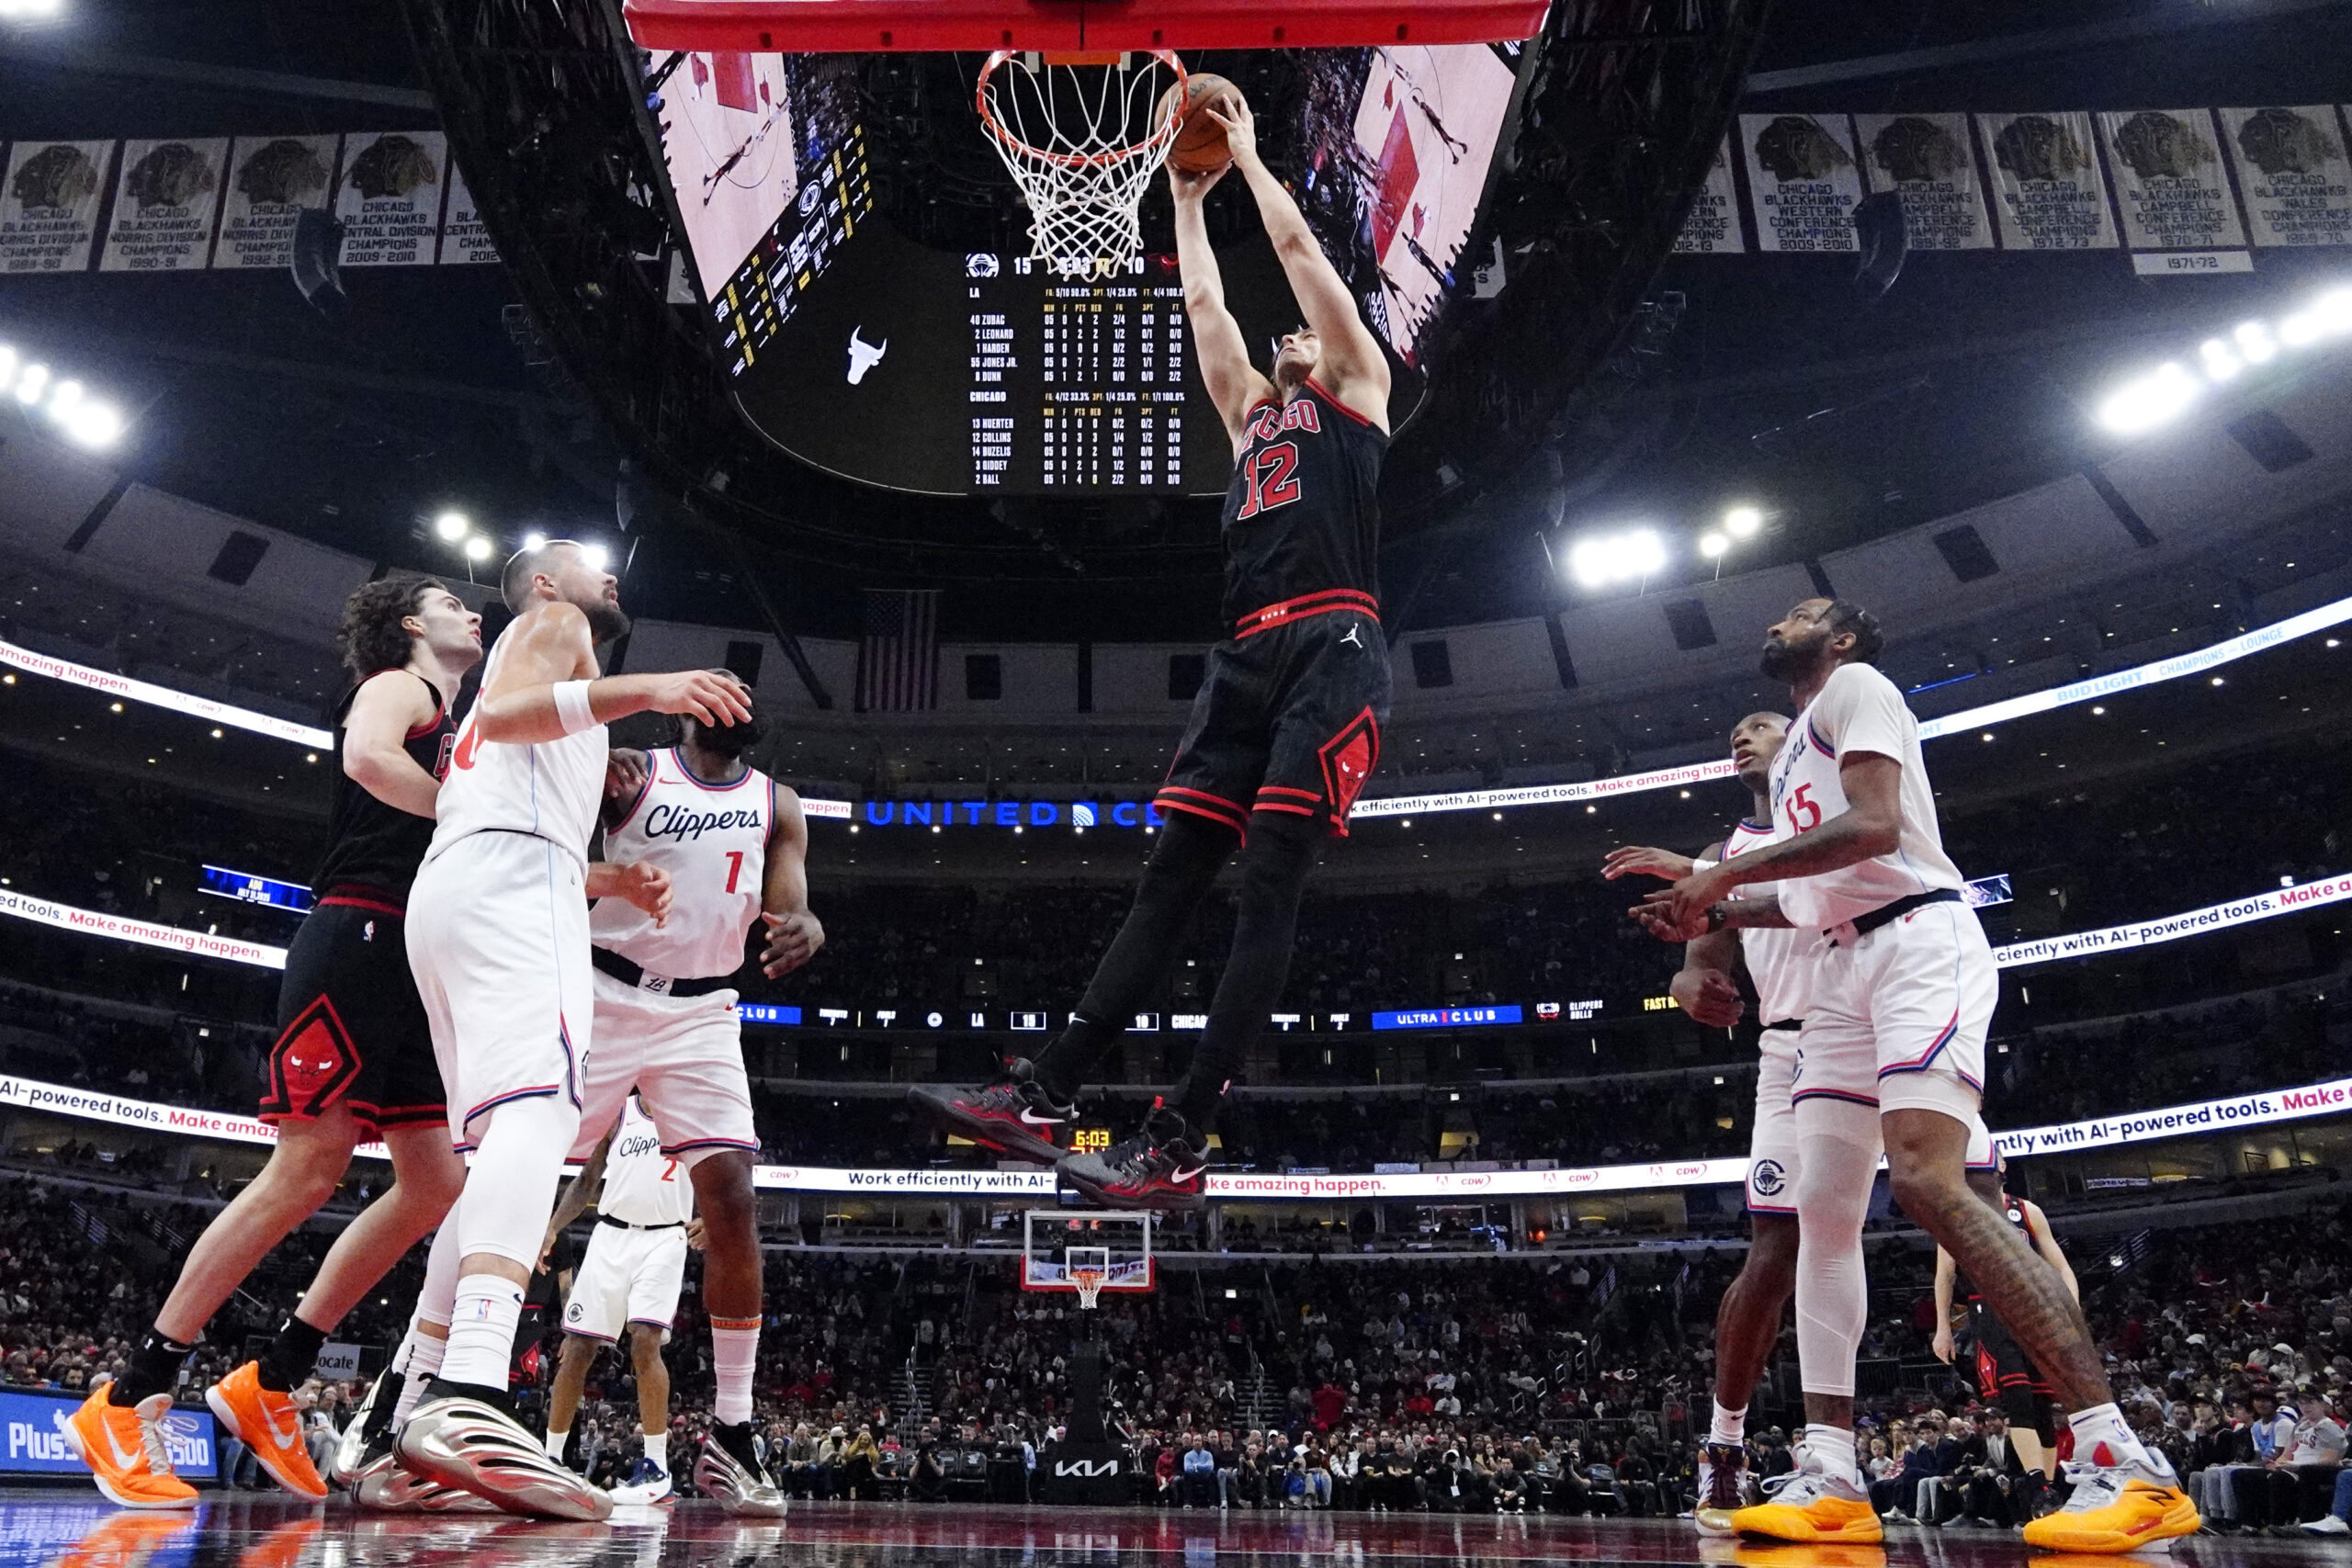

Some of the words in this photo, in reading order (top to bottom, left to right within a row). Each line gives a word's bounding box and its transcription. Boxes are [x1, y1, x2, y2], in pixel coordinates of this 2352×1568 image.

[1778, 184, 1833, 195] CHICAGO
[1765, 195, 1852, 206] BLACKHAWKS
[362, 202, 413, 212] CHICAGO
[1778, 207, 1842, 217] WESTERN
[344, 213, 426, 225] BLACKHAWKS
[1770, 217, 1855, 228] CONFERENCE
[390, 226, 435, 236] DIVISION
[1777, 229, 1852, 240] CHAMPIONS
[347, 238, 417, 250] CHAMPIONS
[1780, 240, 1853, 251] 2009-2010
[1013, 257, 1032, 275] 15
[2167, 256, 2219, 269] 1971-72
[969, 288, 979, 298] LA
[1166, 288, 1184, 297] 100.0
[970, 315, 980, 325] 40
[982, 315, 1005, 325] ZUBAC
[1045, 314, 1054, 325] 05
[1062, 314, 1068, 325] 0
[1078, 314, 1083, 325] 4
[1093, 314, 1099, 325] 2
[1114, 314, 1125, 325] 2/4
[1142, 314, 1154, 325] 0/0
[1170, 314, 1182, 325] 0/0
[975, 329, 980, 339] 2
[982, 329, 1013, 339] LEONARD
[977, 344, 980, 353] 1
[982, 344, 1010, 353] HARDEN
[971, 357, 980, 367] 55
[982, 357, 1004, 367] JONES
[976, 371, 980, 381] 8
[982, 371, 1001, 381] DUNN
[970, 391, 1006, 401] CHICAGO
[972, 418, 980, 428] 13
[982, 418, 1013, 428] HUERTER
[972, 433, 980, 443] 12
[982, 433, 1011, 443] COLLINS
[972, 446, 980, 457] 14
[982, 446, 1011, 457] BUZELIS
[976, 460, 980, 470] 3
[982, 460, 1007, 470] GIDDEY
[976, 474, 980, 484] 2
[982, 474, 1000, 484] BALL
[1237, 441, 1301, 520] 12
[2159, 649, 2226, 676] CHAMPIONS
[2241, 626, 2286, 651] LOUNGE
[68, 666, 131, 693] happen.
[2057, 686, 2091, 703] BUD
[2092, 671, 2143, 694] LIGHT
[1917, 721, 1942, 737] GHT
[1362, 797, 1429, 812] efficiently
[1433, 794, 1463, 807] with
[1467, 788, 1549, 805] AI-powered
[1553, 785, 1592, 797] tools.
[1596, 777, 1633, 793] Make
[1636, 769, 1700, 786] amazing
[1702, 763, 1738, 778] happ
[865, 802, 1058, 826] UNITED
[645, 805, 762, 842] Clippers
[725, 852, 743, 894] 1
[2064, 933, 2105, 951] with
[2110, 909, 2221, 942] AI-powered
[2223, 898, 2277, 919] tools.
[2280, 886, 2335, 907] Make
[21, 899, 63, 920] tools.
[69, 911, 117, 931] Make
[121, 927, 196, 950] amazing
[199, 937, 265, 960] happen.
[1569, 999, 1603, 1010] CLIPPERS
[1644, 998, 1667, 1010] FAST
[736, 1006, 777, 1020] CLUB
[1396, 1013, 1437, 1024] ULTRA
[1452, 1010, 1496, 1021] CLUB
[1570, 1010, 1592, 1020] BULLS
[971, 1013, 985, 1027] LA
[1023, 1014, 1036, 1028] 15
[1135, 1015, 1148, 1028] 10
[1171, 1014, 1208, 1029] CHICAG
[0, 1081, 111, 1113] AI-powered
[116, 1101, 164, 1123] tools.
[169, 1111, 222, 1132] Make
[226, 1120, 278, 1139] amaz
[2041, 1127, 2085, 1146] with
[2090, 1106, 2212, 1140] AI-powered
[2216, 1099, 2278, 1121] tools.
[2282, 1089, 2345, 1111] Make
[1076, 1131, 1109, 1146] 6:03
[620, 1135, 660, 1157] Clipp
[662, 1157, 677, 1182] 2
[1676, 1167, 1700, 1176] CDW
[849, 1172, 892, 1185] Work
[896, 1172, 982, 1190] efficiently
[987, 1172, 1023, 1187] with
[1461, 1177, 1484, 1186] CDW
[1568, 1174, 1592, 1183] CDW
[1235, 1177, 1310, 1194] amazing
[1315, 1178, 1386, 1194] happen.
[1056, 1460, 1118, 1476] KIA
